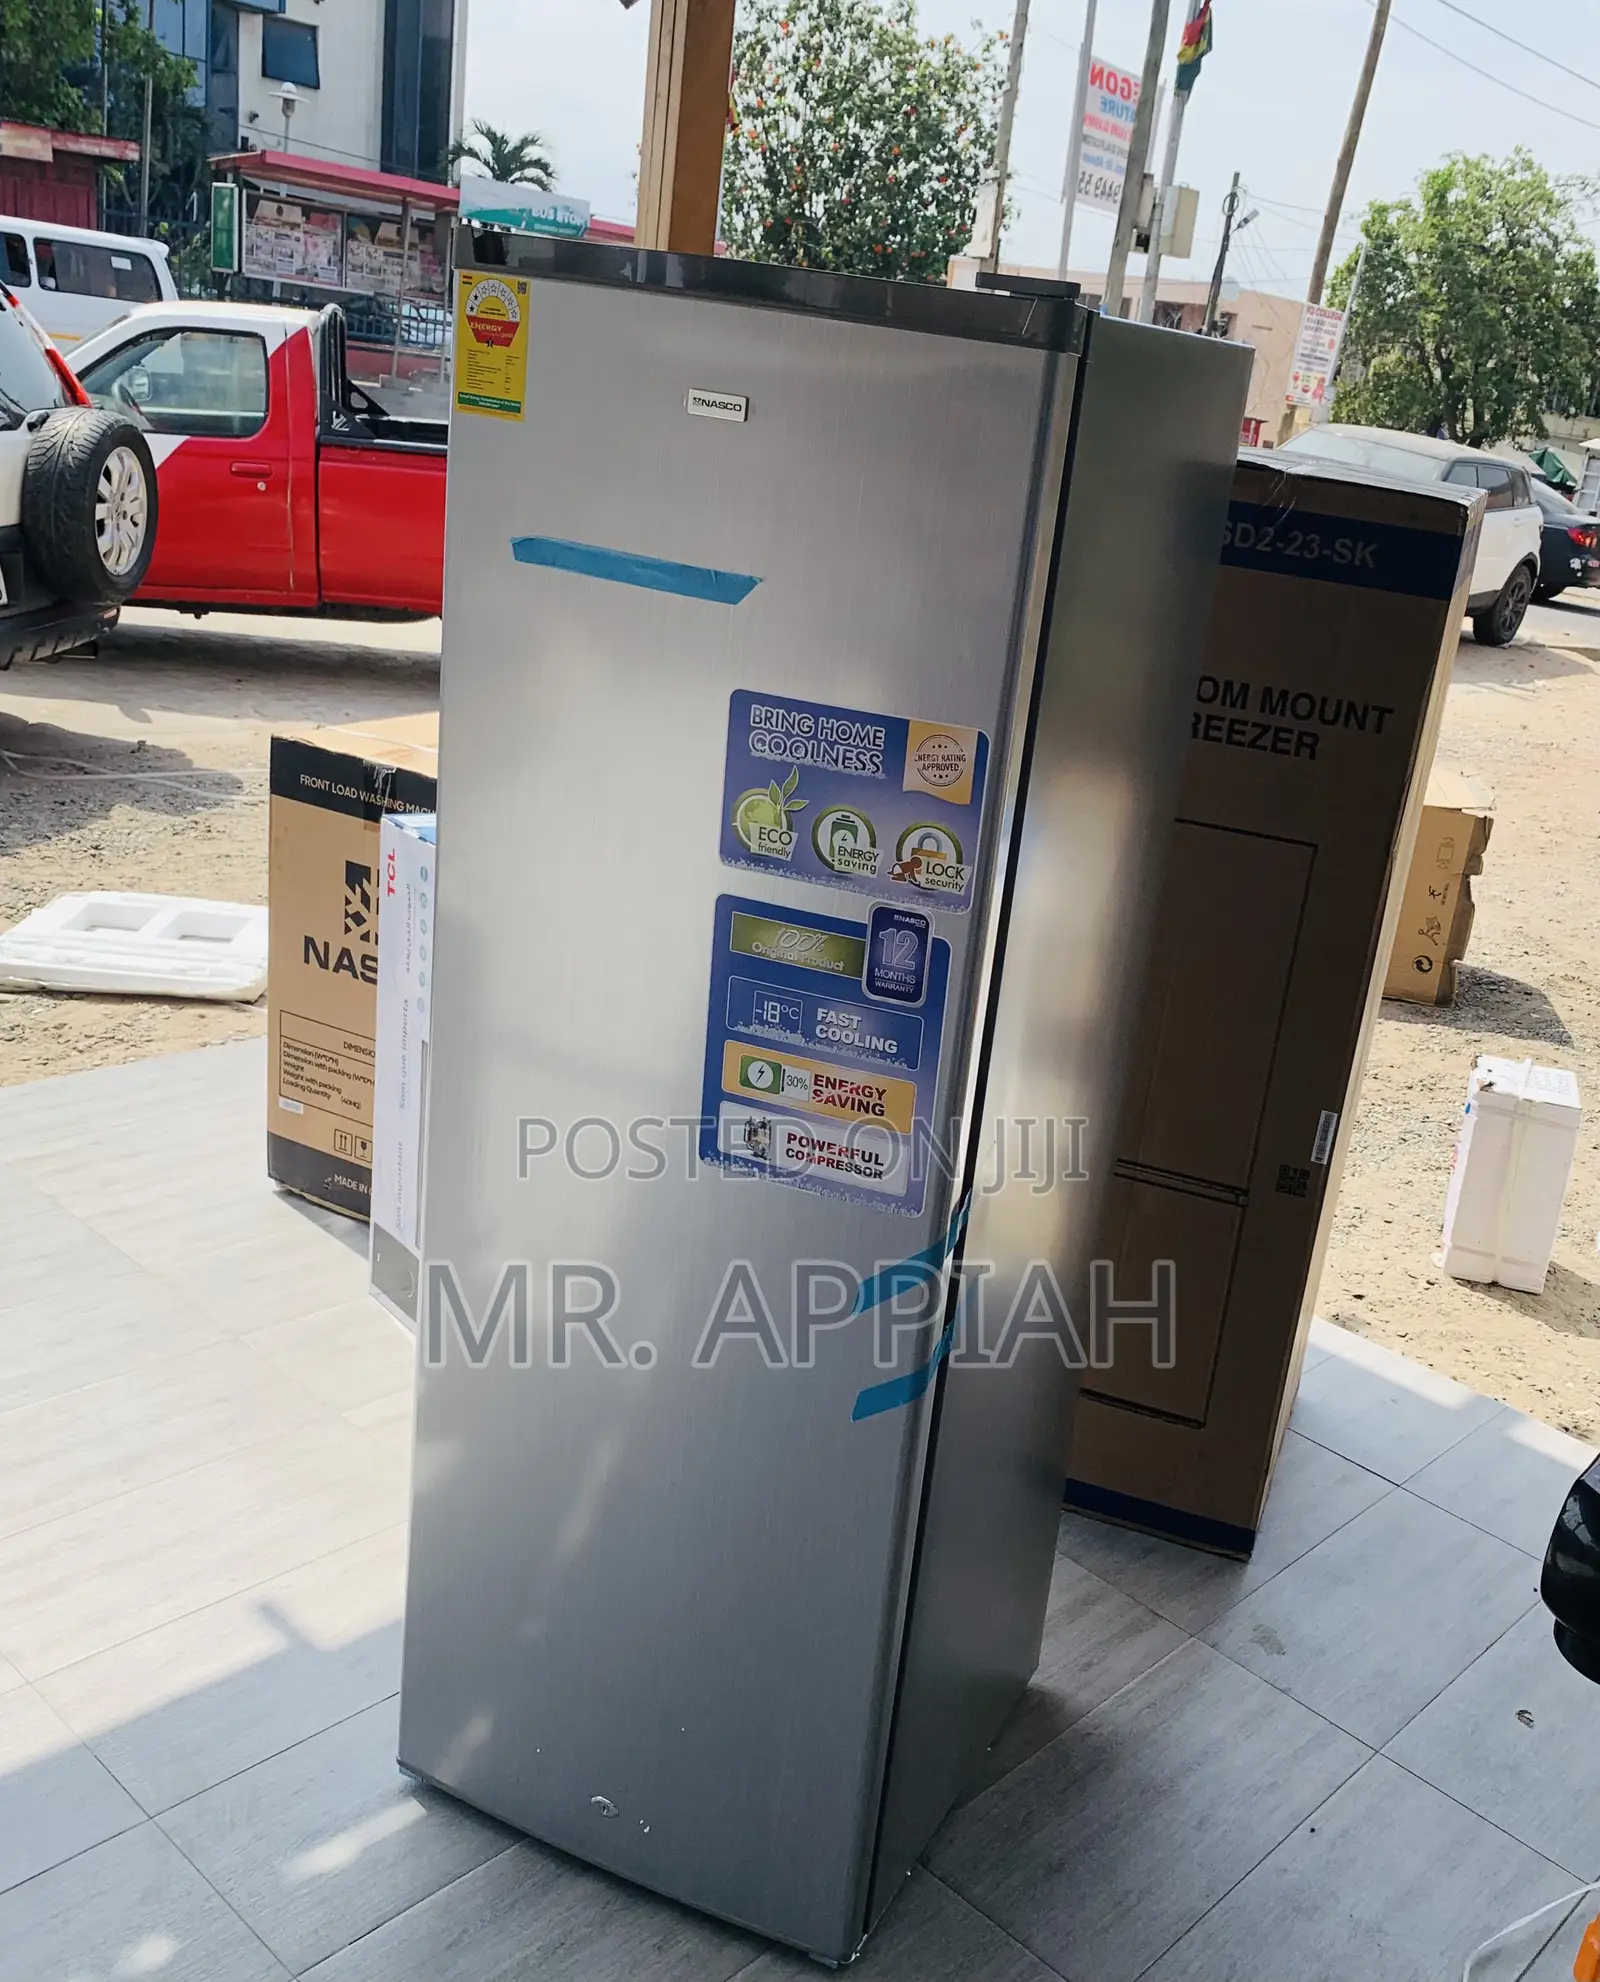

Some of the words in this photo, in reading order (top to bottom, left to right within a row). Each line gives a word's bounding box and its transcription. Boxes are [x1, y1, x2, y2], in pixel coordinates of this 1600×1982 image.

[470, 321, 503, 332] ENERGY
[701, 399, 742, 412] NASCO
[1196, 675, 1250, 711] OM
[1258, 686, 1394, 735] MOUNT
[750, 704, 815, 737] BRING
[818, 716, 885, 750] HOME
[749, 729, 885, 777] COOLNESS
[940, 753, 967, 763] RATING
[921, 762, 960, 772] APPROVED
[299, 773, 331, 793] FRONT
[331, 782, 358, 799] LOAD
[358, 790, 405, 812] WASHING
[758, 826, 793, 846] ECO
[757, 843, 792, 860] friendly
[837, 845, 881, 863] ENERGY
[386, 848, 396, 898] TCL
[837, 857, 878, 875] saving
[925, 860, 966, 881] LOCK
[924, 876, 965, 892] security
[773, 927, 829, 953] 100%
[878, 927, 919, 971] 12
[303, 934, 378, 986] NAS
[751, 941, 798, 961] Original
[801, 951, 845, 971] Product
[874, 967, 916, 985] MONTHS
[874, 980, 915, 994] WARRANTY
[816, 1007, 861, 1031] FAST
[283, 1041, 314, 1058] Dimension
[815, 1024, 898, 1054] COOLING
[282, 1050, 314, 1066] Dimension
[314, 1061, 328, 1072] with
[327, 1066, 352, 1080] packing
[283, 1060, 305, 1073] Weight
[282, 1068, 305, 1081] Weight
[304, 1076, 319, 1087] with
[318, 1081, 342, 1095] packing
[282, 1077, 306, 1092] Loading
[306, 1085, 331, 1100] Quantity
[786, 1074, 808, 1091] 30%
[813, 1073, 887, 1102] ENERGY
[811, 1088, 886, 1118] SAVING
[786, 1131, 884, 1167] POWERFUL
[785, 1147, 884, 1181] COMPRESSOR
[333, 1173, 358, 1191] MADE
[358, 1183, 368, 1195] IN
